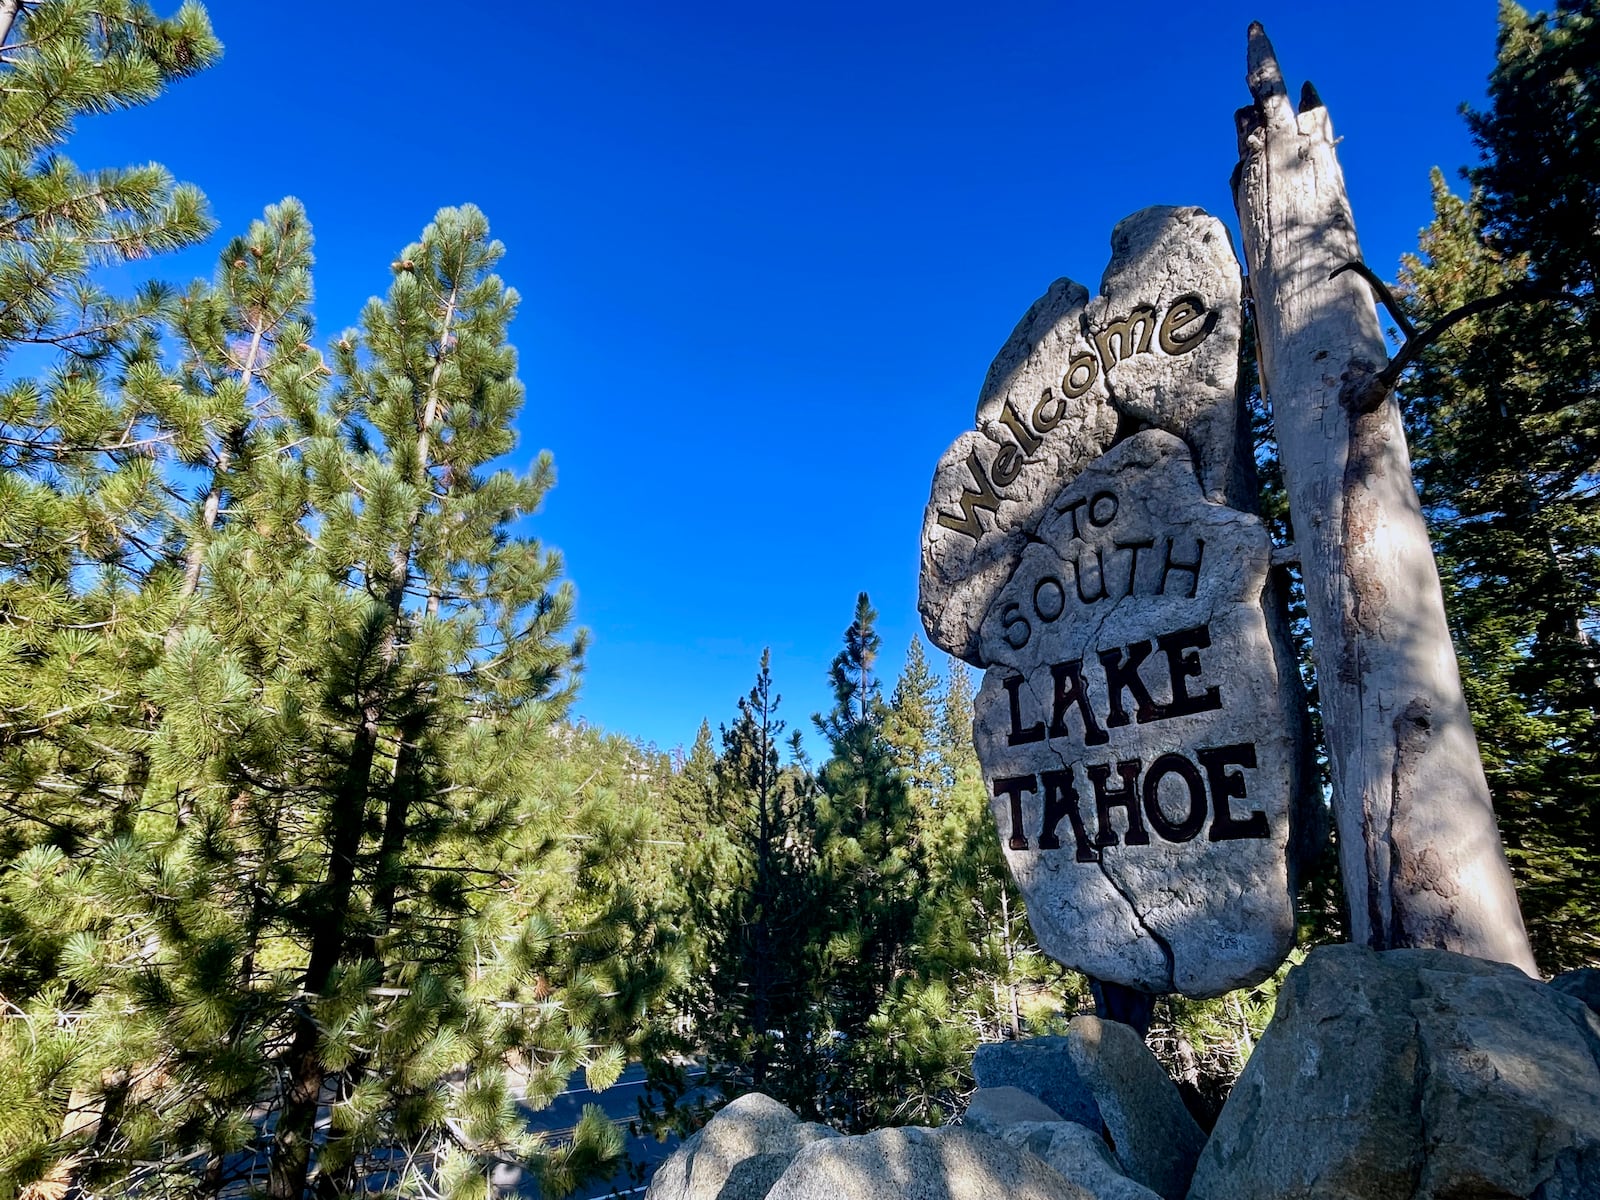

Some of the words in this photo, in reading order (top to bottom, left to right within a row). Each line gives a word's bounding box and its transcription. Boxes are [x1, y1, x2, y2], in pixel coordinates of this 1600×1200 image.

[938, 291, 1219, 540] Welcome
[1057, 490, 1119, 540] TO
[1002, 536, 1205, 650] SOUTH
[1002, 625, 1223, 747] LAKE
[993, 743, 1271, 863] TAHOE
